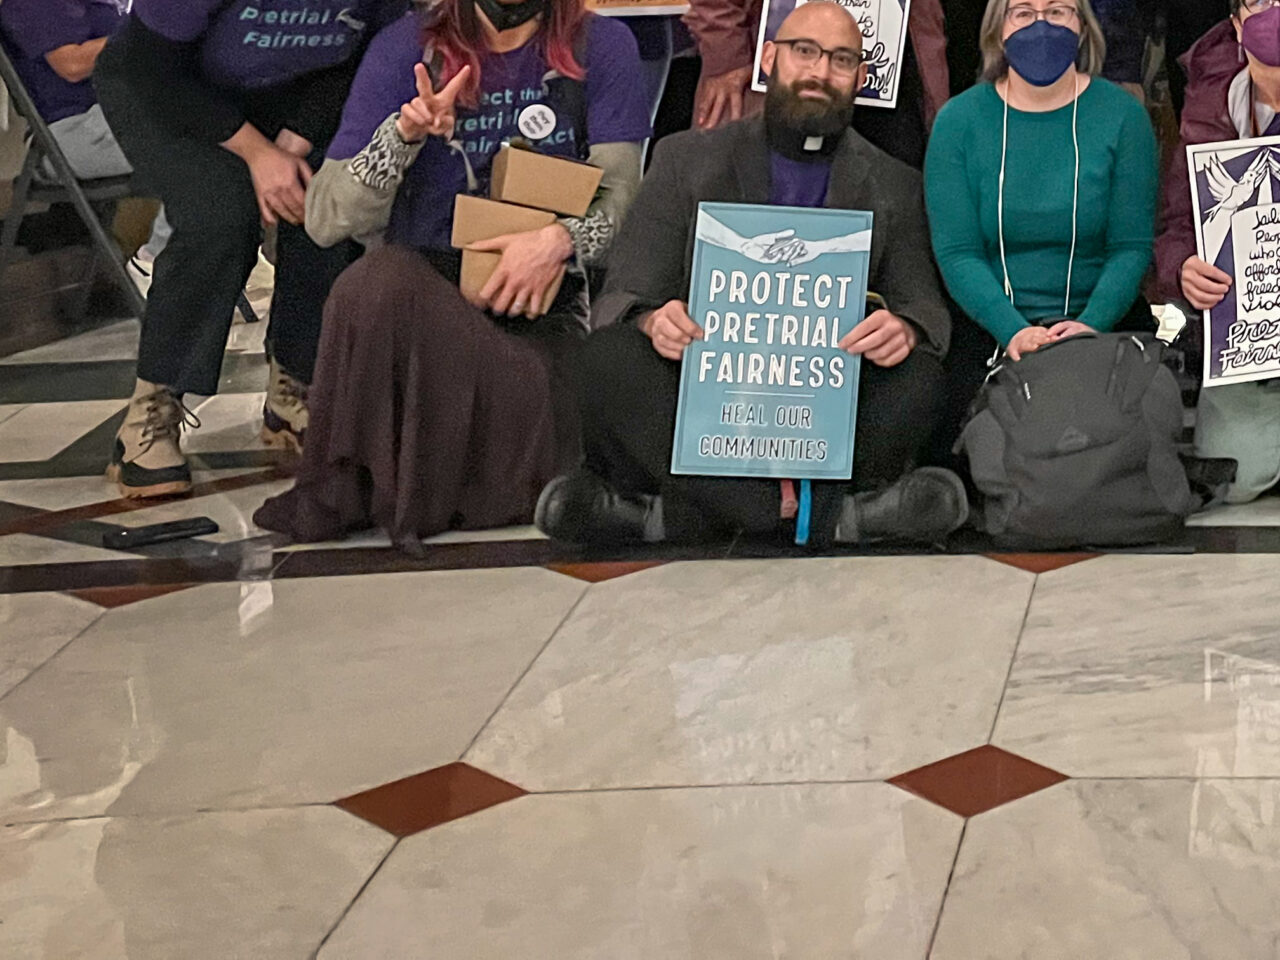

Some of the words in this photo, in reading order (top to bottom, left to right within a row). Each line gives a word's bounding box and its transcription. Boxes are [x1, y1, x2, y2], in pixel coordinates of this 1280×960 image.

[243, 31, 346, 48] Fairness
[1249, 244, 1275, 260] who
[708, 269, 853, 310] PROTECT
[703, 310, 841, 350] PRETRIAL
[698, 350, 845, 389] FAIRNESS
[721, 403, 767, 426] HEAL
[775, 406, 812, 428] OUR
[699, 436, 828, 461] COMMUNITIES
